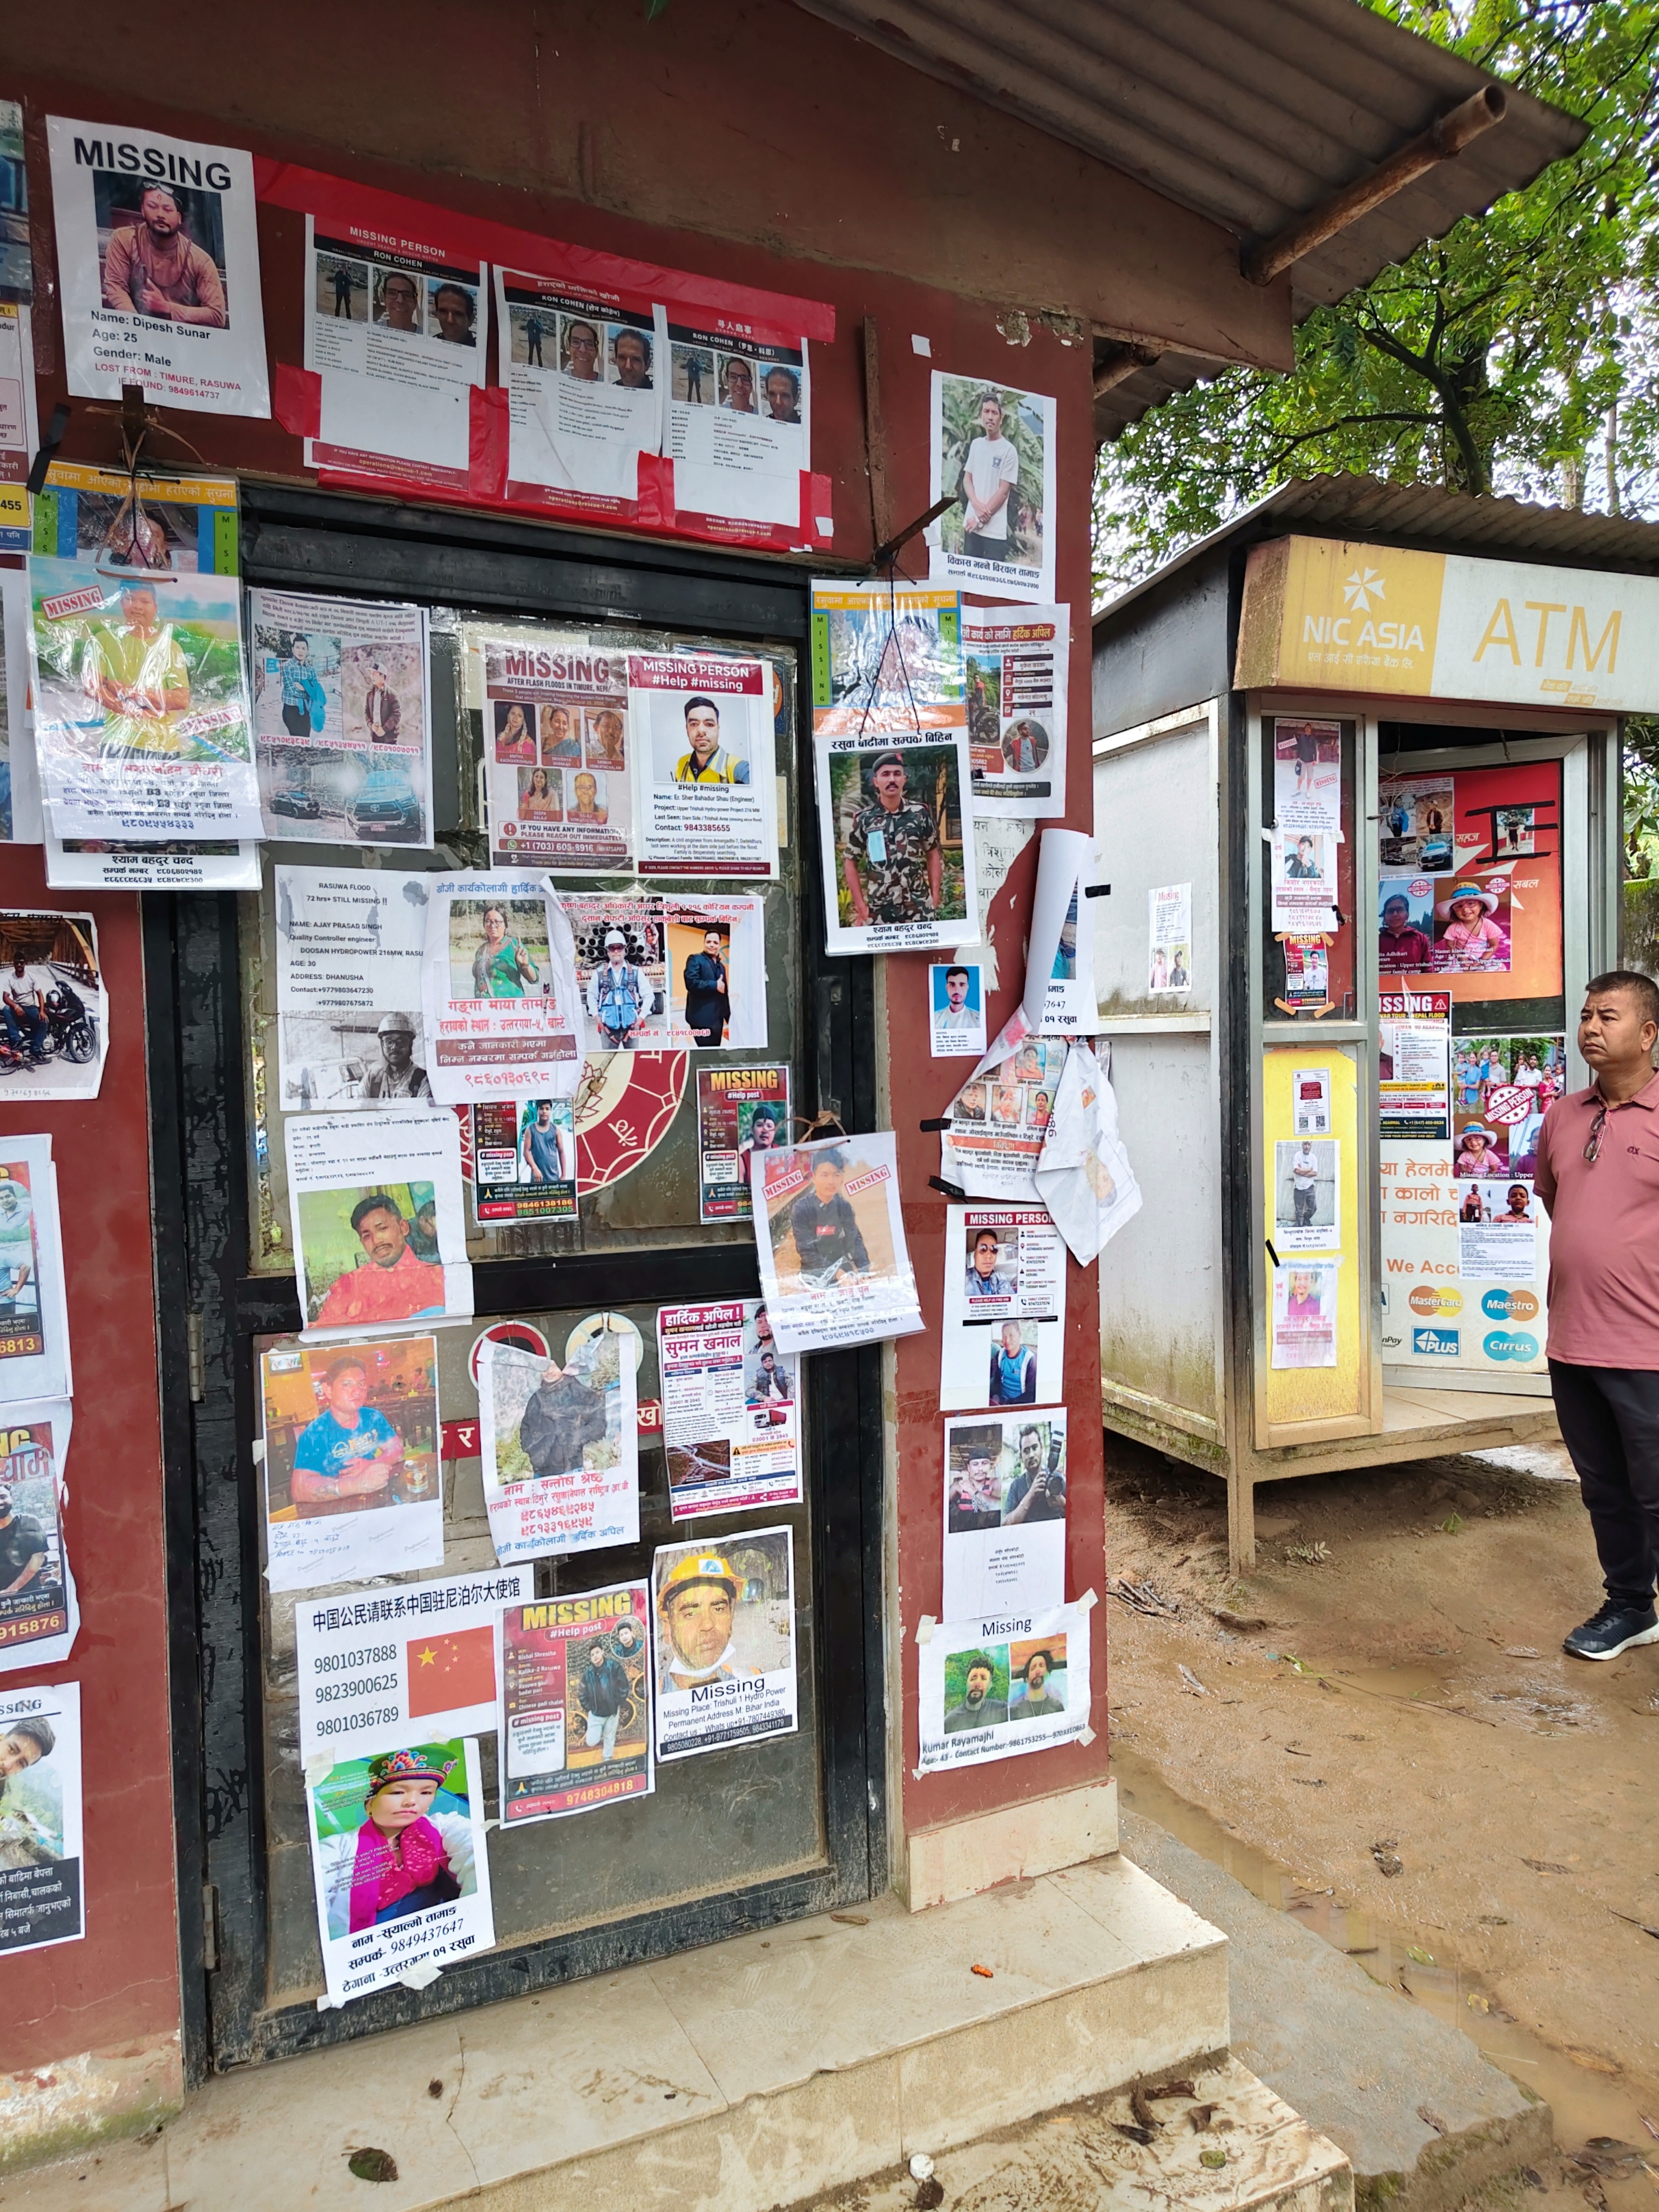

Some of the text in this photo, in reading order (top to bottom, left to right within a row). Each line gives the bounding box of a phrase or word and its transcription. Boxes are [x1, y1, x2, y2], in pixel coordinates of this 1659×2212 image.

[74, 137, 231, 191] MISSING
[350, 226, 445, 258] MISSING PERSON
[374, 251, 422, 267] RON COHEN
[560, 298, 584, 309] COHEN
[599, 292, 620, 301] खोजी
[91, 311, 210, 339] Name: Dipesh Sunar
[718, 319, 752, 334] 寻人启事
[92, 328, 137, 342] Age: 25
[93, 347, 140, 360] Gender:
[95, 363, 241, 390] LOST TIMURE, RASUWA
[168, 386, 220, 399] 9849614737
[206, 489, 233, 503] सुचना
[948, 555, 971, 567] विकास
[45, 590, 101, 617] MISSING
[934, 595, 955, 606] सुचना
[1031, 627, 1051, 638] अपिल
[1303, 615, 1425, 652] NIC ASIA
[1472, 597, 1622, 675] ATM
[505, 650, 609, 683] MISSING
[1309, 652, 1320, 664] एन
[1324, 651, 1339, 665] आई
[1343, 652, 1353, 665] सी
[1356, 651, 1380, 667] एशिया
[643, 661, 749, 678] MISSING PERSON
[508, 677, 524, 686] AFTER
[545, 680, 565, 689] FLOODS
[574, 683, 595, 692] TIMURE,
[652, 675, 743, 692] #Help #missing
[831, 732, 953, 750] रसुवा बिहिन
[1455, 833, 1480, 842] सहज
[532, 842, 554, 851] (703)
[112, 855, 193, 867] श्याम बहदुर चन्द
[436, 883, 455, 893] खोजी
[1158, 890, 1179, 901] Missing
[603, 901, 633, 910] अधिकारी
[873, 922, 933, 934] श्याम बहदुर चन्द
[289, 934, 312, 942] Quality
[489, 1000, 516, 1010] माया
[458, 1039, 547, 1053] कुनै जानकारी भएमा
[711, 1070, 778, 1091] MISSING
[1509, 1088, 1534, 1108] PERSON
[764, 1172, 802, 1197] MISSING
[847, 1168, 888, 1193] MISSING
[1395, 1183, 1441, 1201] कालो
[517, 1199, 572, 1208] 9846138186
[970, 1214, 1013, 1224] MISSING
[1386, 1258, 1414, 1273] We
[1411, 1296, 1534, 1311] MasterCard Maestro
[665, 1309, 733, 1325] हार्दिक अपिल
[665, 1335, 741, 1358] सुमन खनाल
[1427, 1340, 1532, 1353] PLUS Cirrus
[504, 1484, 524, 1495] नाम
[313, 1577, 521, 1632] 中国公民请联系中国驻尼泊尔大使馆
[522, 1591, 632, 1631] MISSING
[550, 1623, 602, 1638] #Help post
[982, 1619, 1031, 1637] Missing
[314, 1644, 397, 1674] 9801037888
[315, 1674, 398, 1703] 9823900625
[691, 1677, 765, 1703] Missing
[664, 1691, 764, 1719] Missing Trishuli Hydro
[316, 1707, 399, 1736] 9801036789
[668, 1711, 733, 1729] Permanent Address
[664, 1732, 687, 1742] Contact
[667, 1719, 784, 1752] 9805080228, 9843341179
[922, 1739, 949, 1754] Kumar
[567, 1779, 633, 1806] 9748304818
[352, 1907, 457, 1948] नाम तामाङ
[390, 1918, 464, 1955] 9849437647
[342, 1936, 475, 1993] ठेगाना रसुवा
